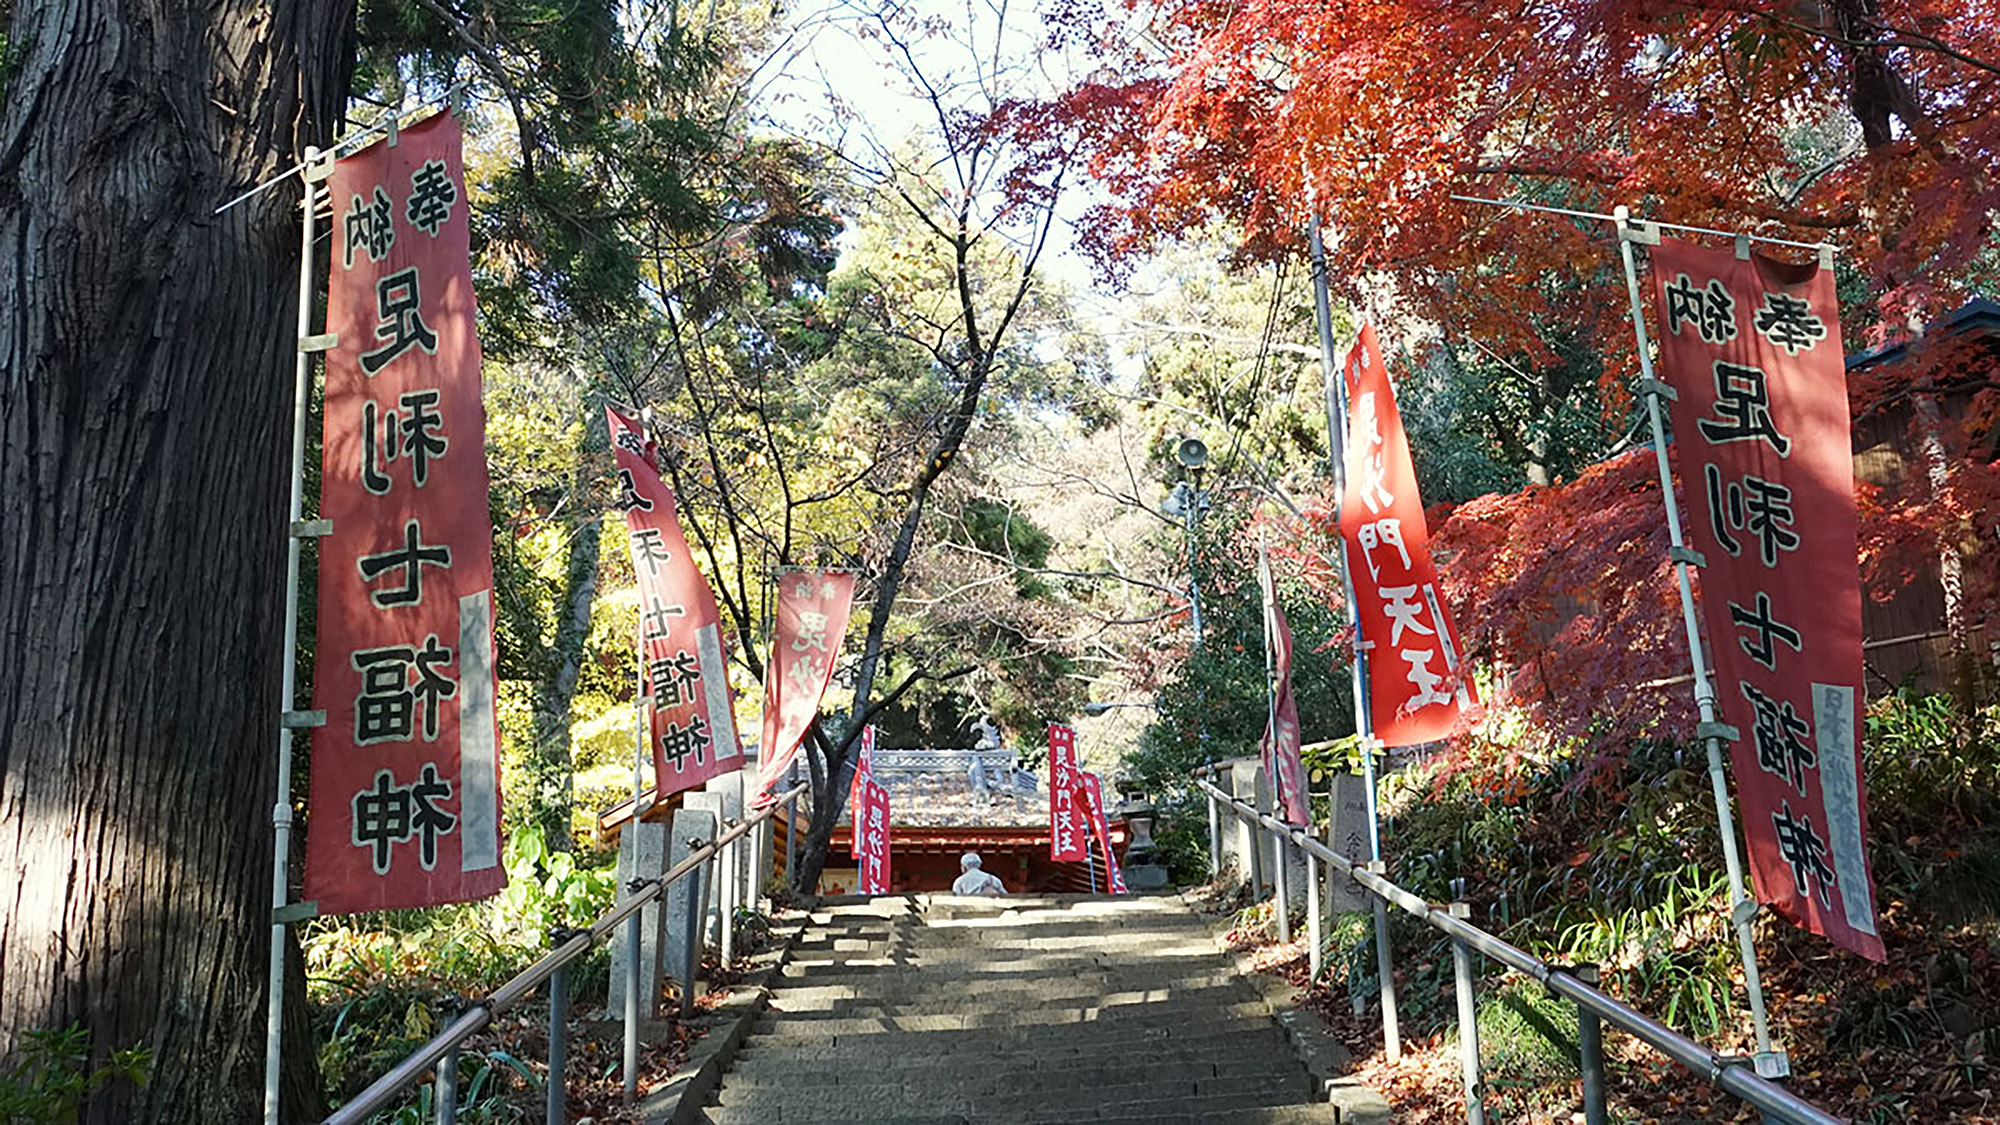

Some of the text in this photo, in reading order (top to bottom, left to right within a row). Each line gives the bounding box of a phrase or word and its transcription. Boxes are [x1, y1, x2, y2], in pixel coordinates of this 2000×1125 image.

[1055, 746, 1077, 852] 毘沙門天王
